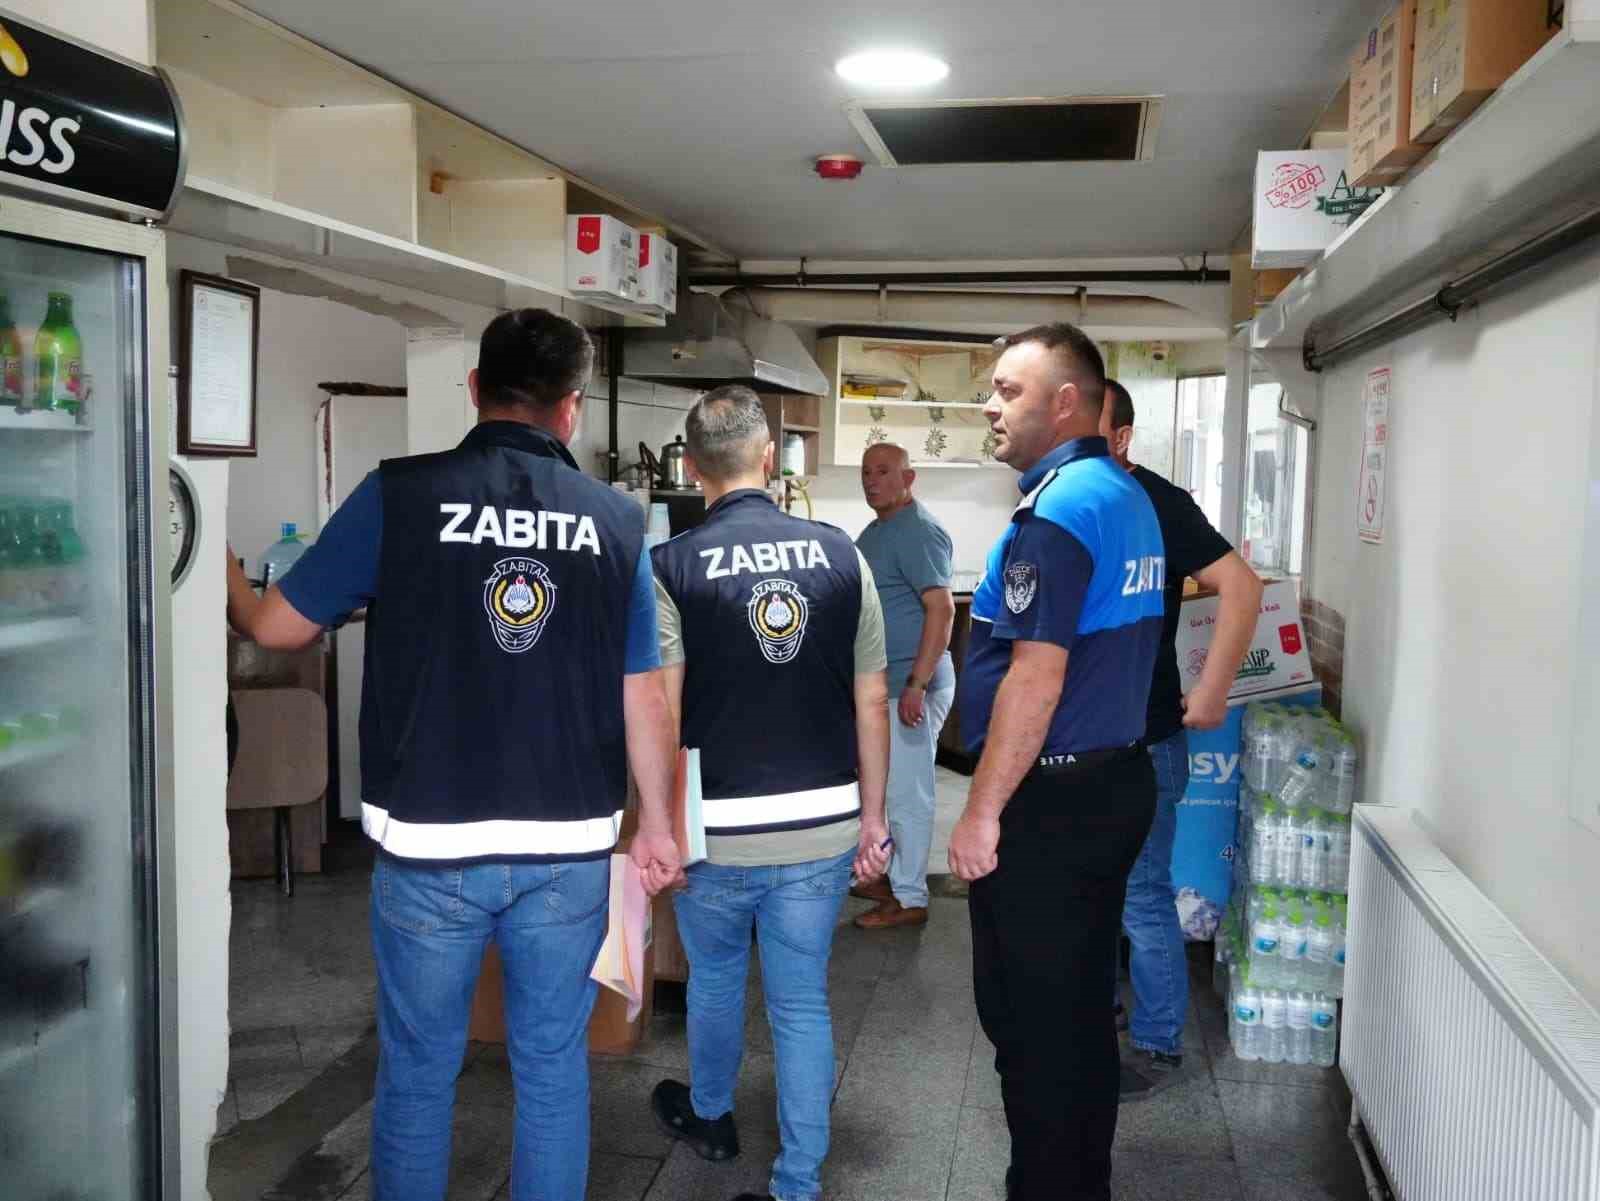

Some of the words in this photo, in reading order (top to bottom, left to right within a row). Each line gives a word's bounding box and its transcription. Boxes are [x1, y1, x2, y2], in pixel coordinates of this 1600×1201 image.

[1273, 172, 1317, 200] %100
[440, 503, 601, 556] ZABITA
[501, 561, 542, 577] ZABITA
[700, 539, 831, 580] ZABITA
[757, 582, 792, 595] ZABITA
